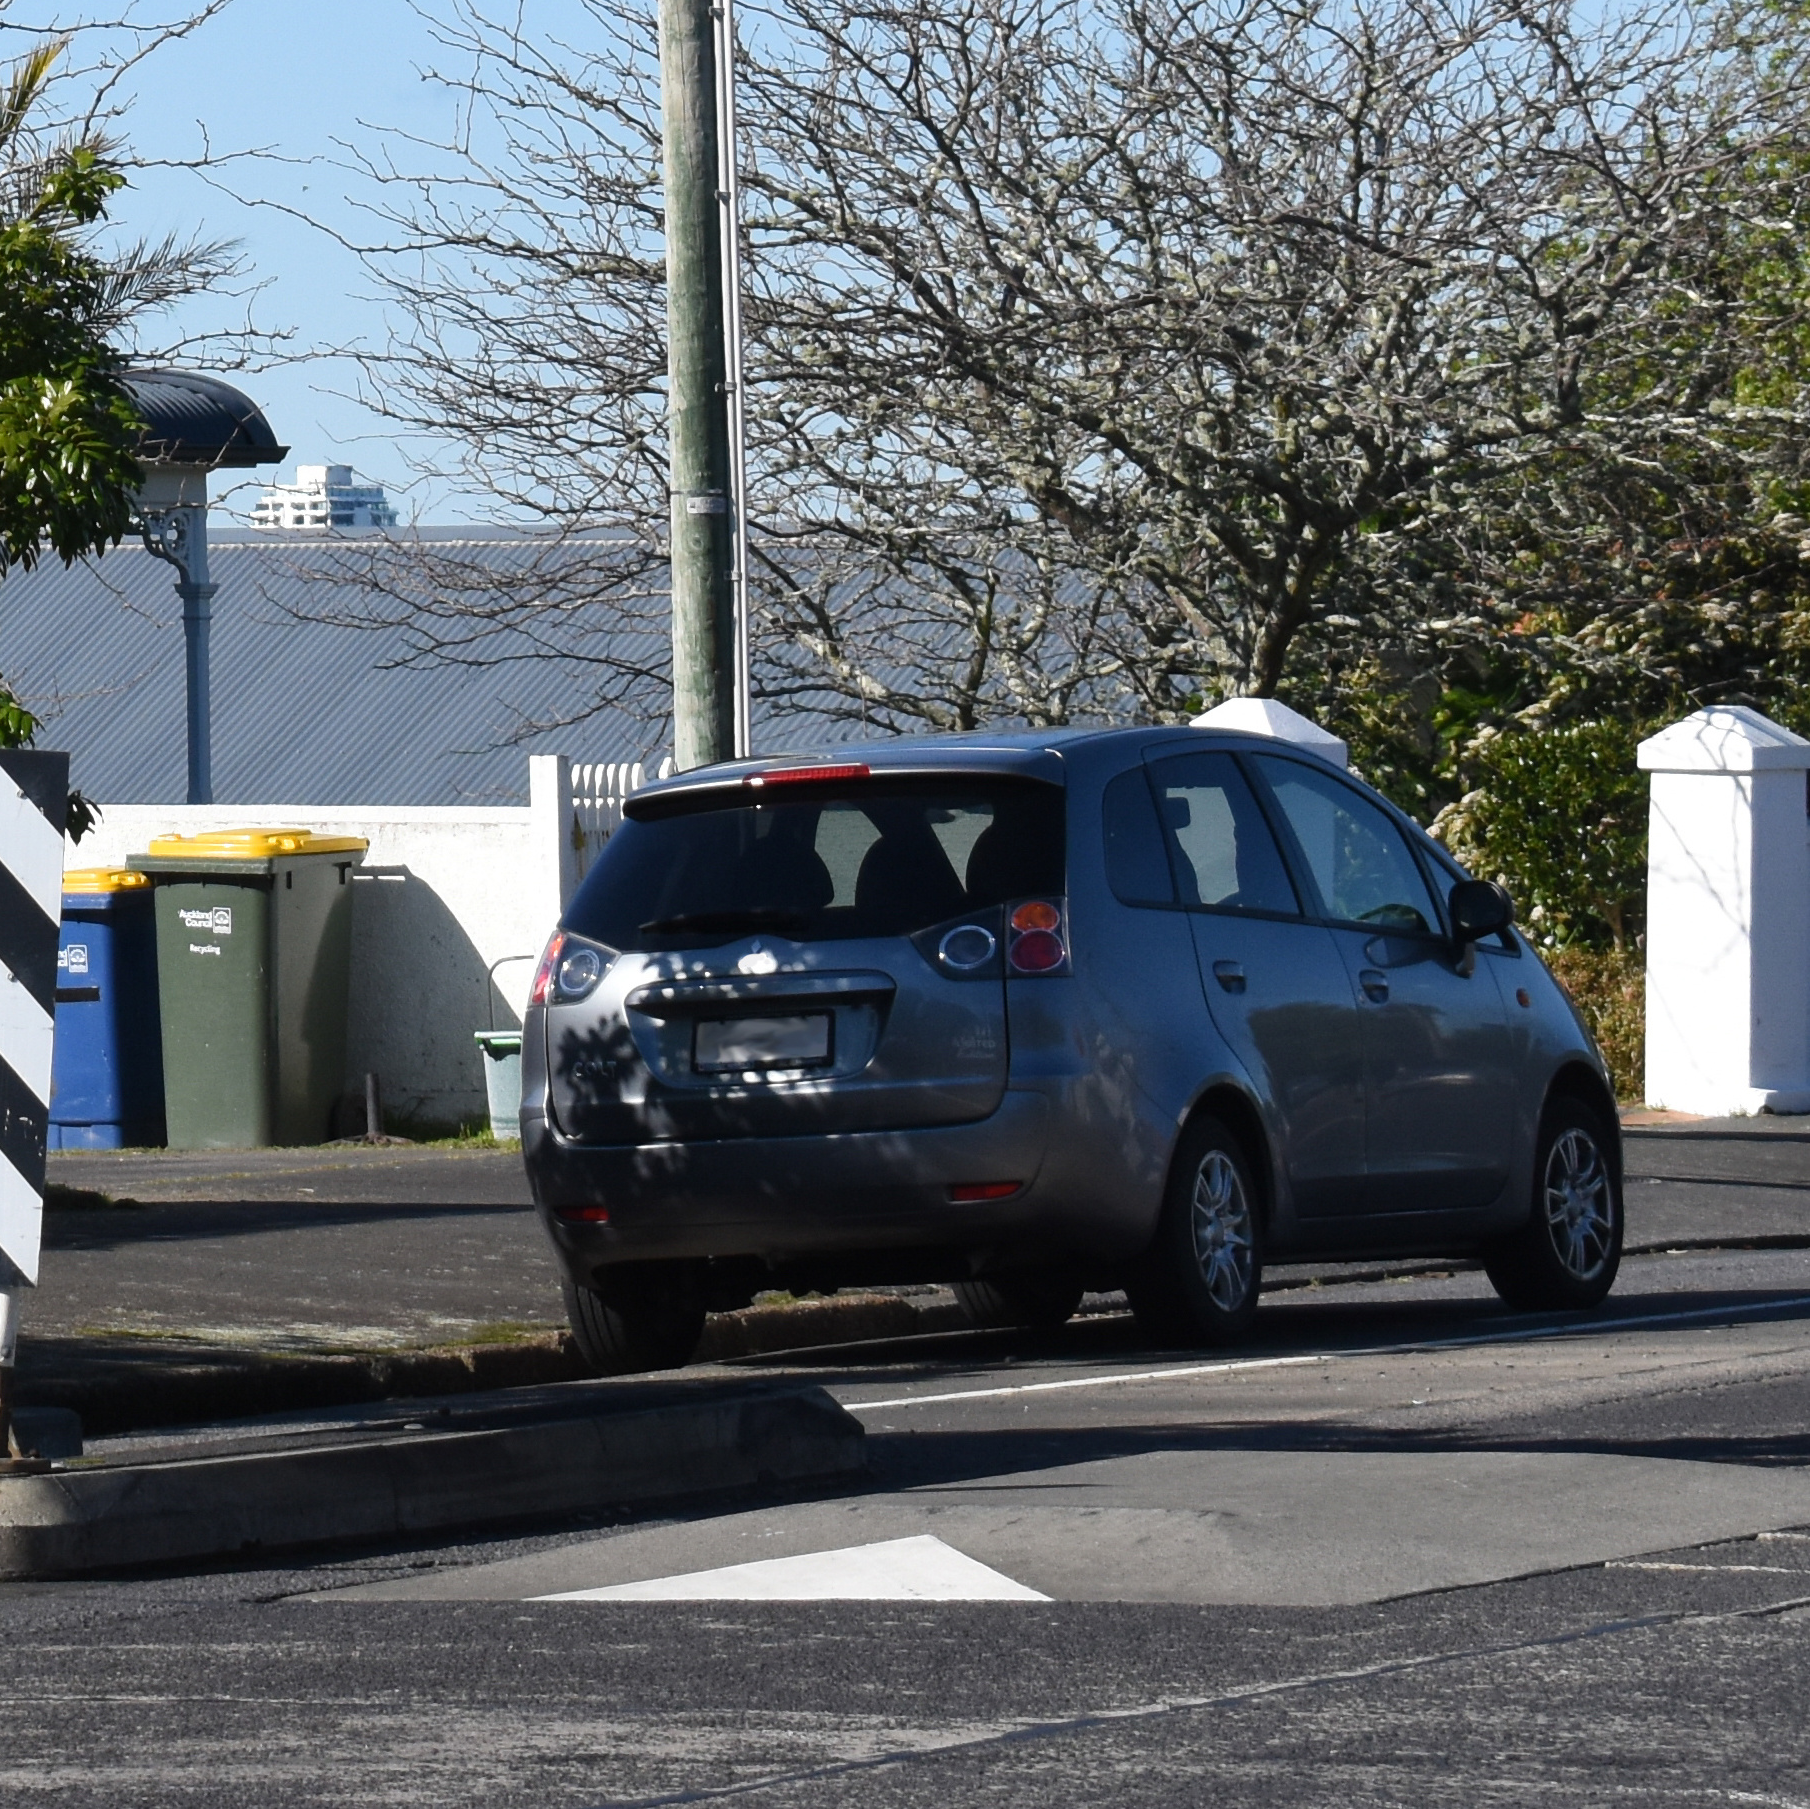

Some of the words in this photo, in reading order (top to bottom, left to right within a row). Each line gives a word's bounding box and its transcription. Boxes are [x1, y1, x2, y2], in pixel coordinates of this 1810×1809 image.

[178, 909, 213, 920] Auckland
[185, 918, 213, 928] Council
[572, 1061, 617, 1078] COLT
